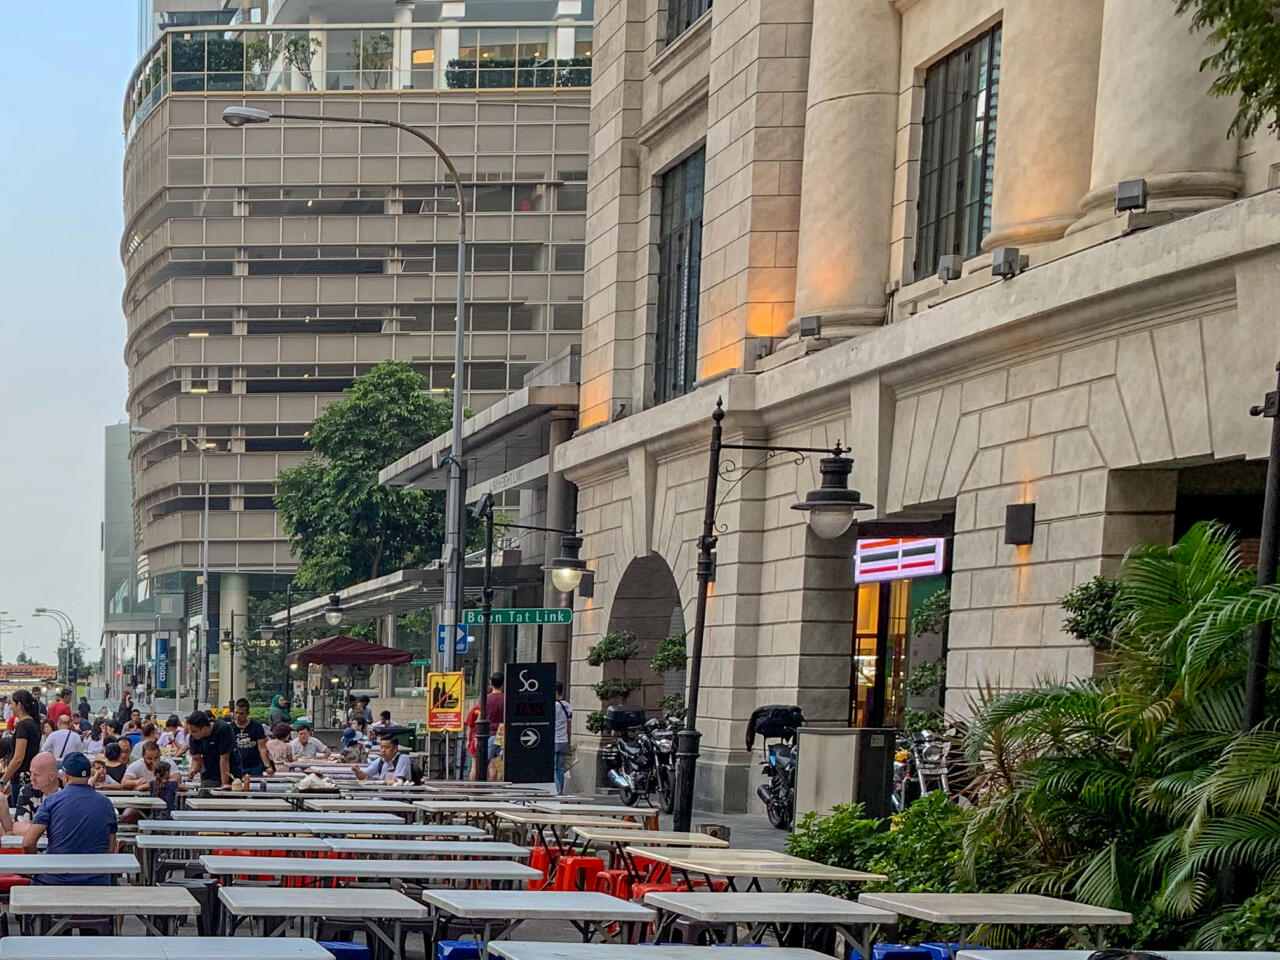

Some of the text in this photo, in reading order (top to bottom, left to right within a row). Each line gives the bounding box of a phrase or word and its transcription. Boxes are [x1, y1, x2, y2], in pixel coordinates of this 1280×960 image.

[508, 611, 530, 622] Tat
[536, 610, 565, 622] Link
[518, 669, 539, 692] So
